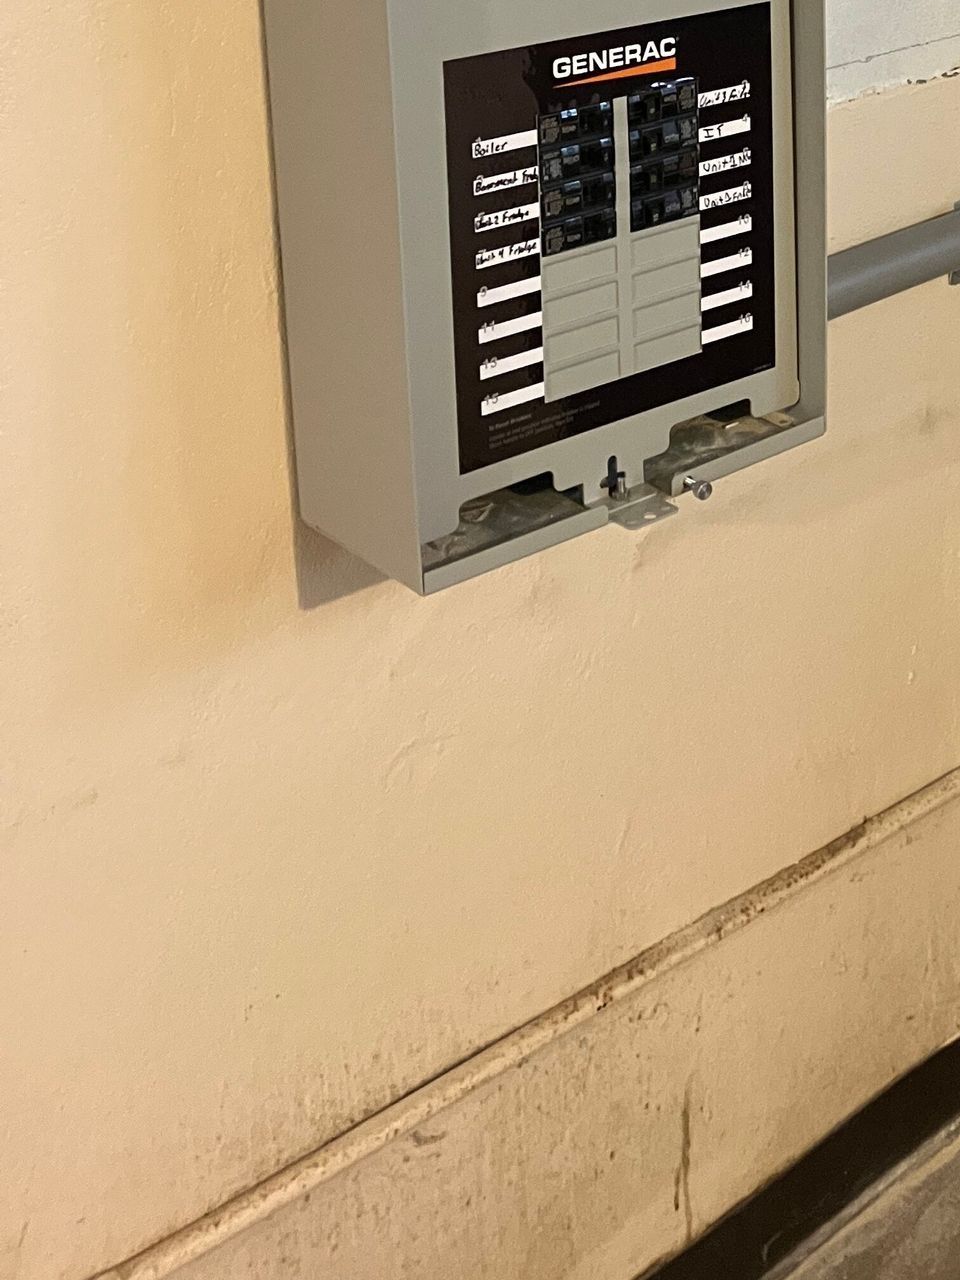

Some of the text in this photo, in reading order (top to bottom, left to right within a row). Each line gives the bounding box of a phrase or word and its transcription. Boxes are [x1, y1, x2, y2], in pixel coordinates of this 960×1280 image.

[552, 37, 677, 79] GENERAC
[474, 141, 508, 157] Boiler
[703, 160, 728, 172] Unit
[502, 208, 530, 222] Fridge
[738, 214, 750, 225] 10
[508, 240, 538, 256] Fridge
[738, 246, 750, 258] 12
[480, 286, 488, 298] 9
[738, 280, 750, 292] 14
[738, 312, 751, 324] 16
[482, 320, 496, 334] 11
[482, 356, 498, 370] 13
[484, 392, 500, 406] 15
